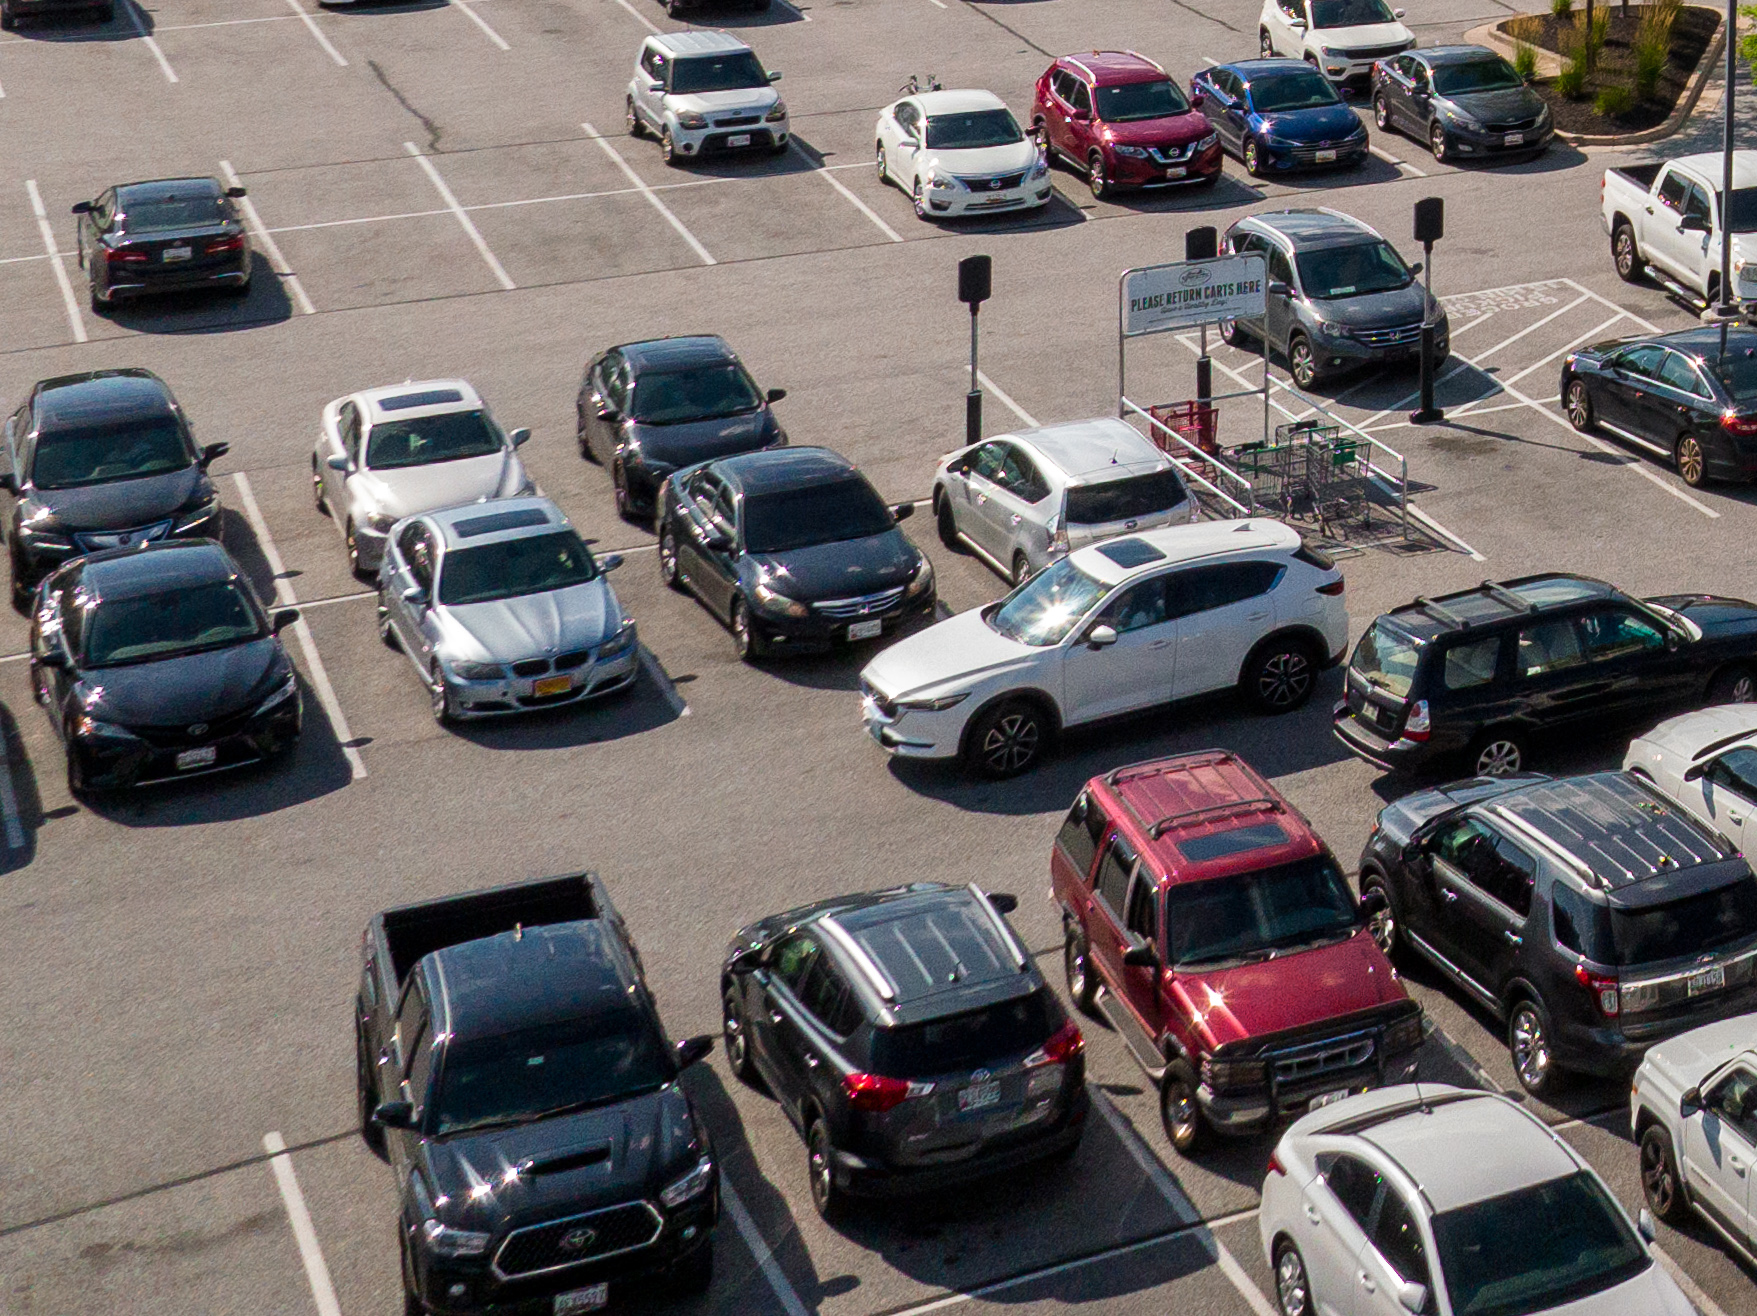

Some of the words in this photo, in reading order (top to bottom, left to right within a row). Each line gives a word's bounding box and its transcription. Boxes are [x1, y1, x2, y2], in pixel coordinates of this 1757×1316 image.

[1131, 293, 1164, 312] PLEASE
[1166, 287, 1202, 306] RETURN
[1204, 282, 1234, 300] CARTS
[1236, 279, 1261, 296] HERE
